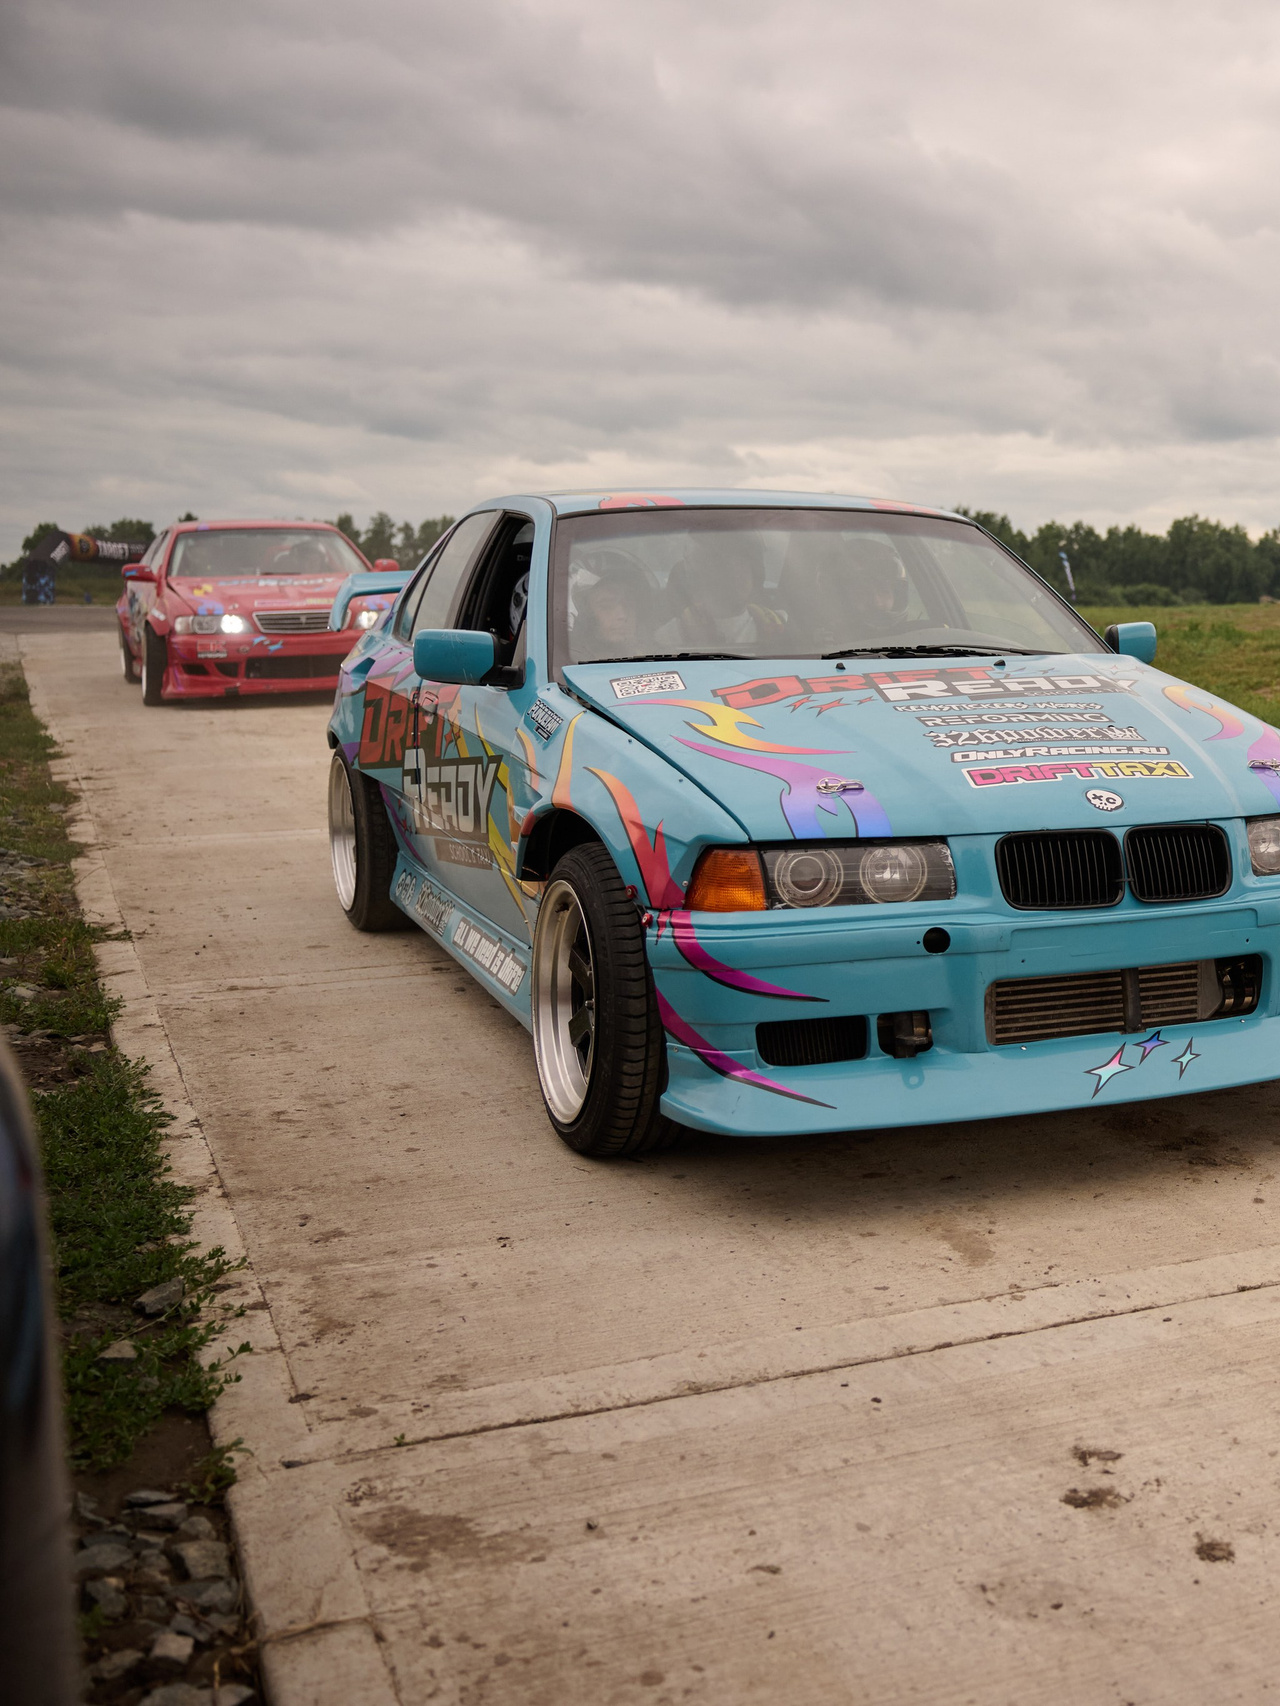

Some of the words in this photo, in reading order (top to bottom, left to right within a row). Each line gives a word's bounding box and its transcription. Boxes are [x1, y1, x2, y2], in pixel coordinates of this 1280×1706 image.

[878, 675, 1135, 701] READY
[895, 702, 1028, 712] KEMSTICKERS
[403, 748, 498, 834] READY
